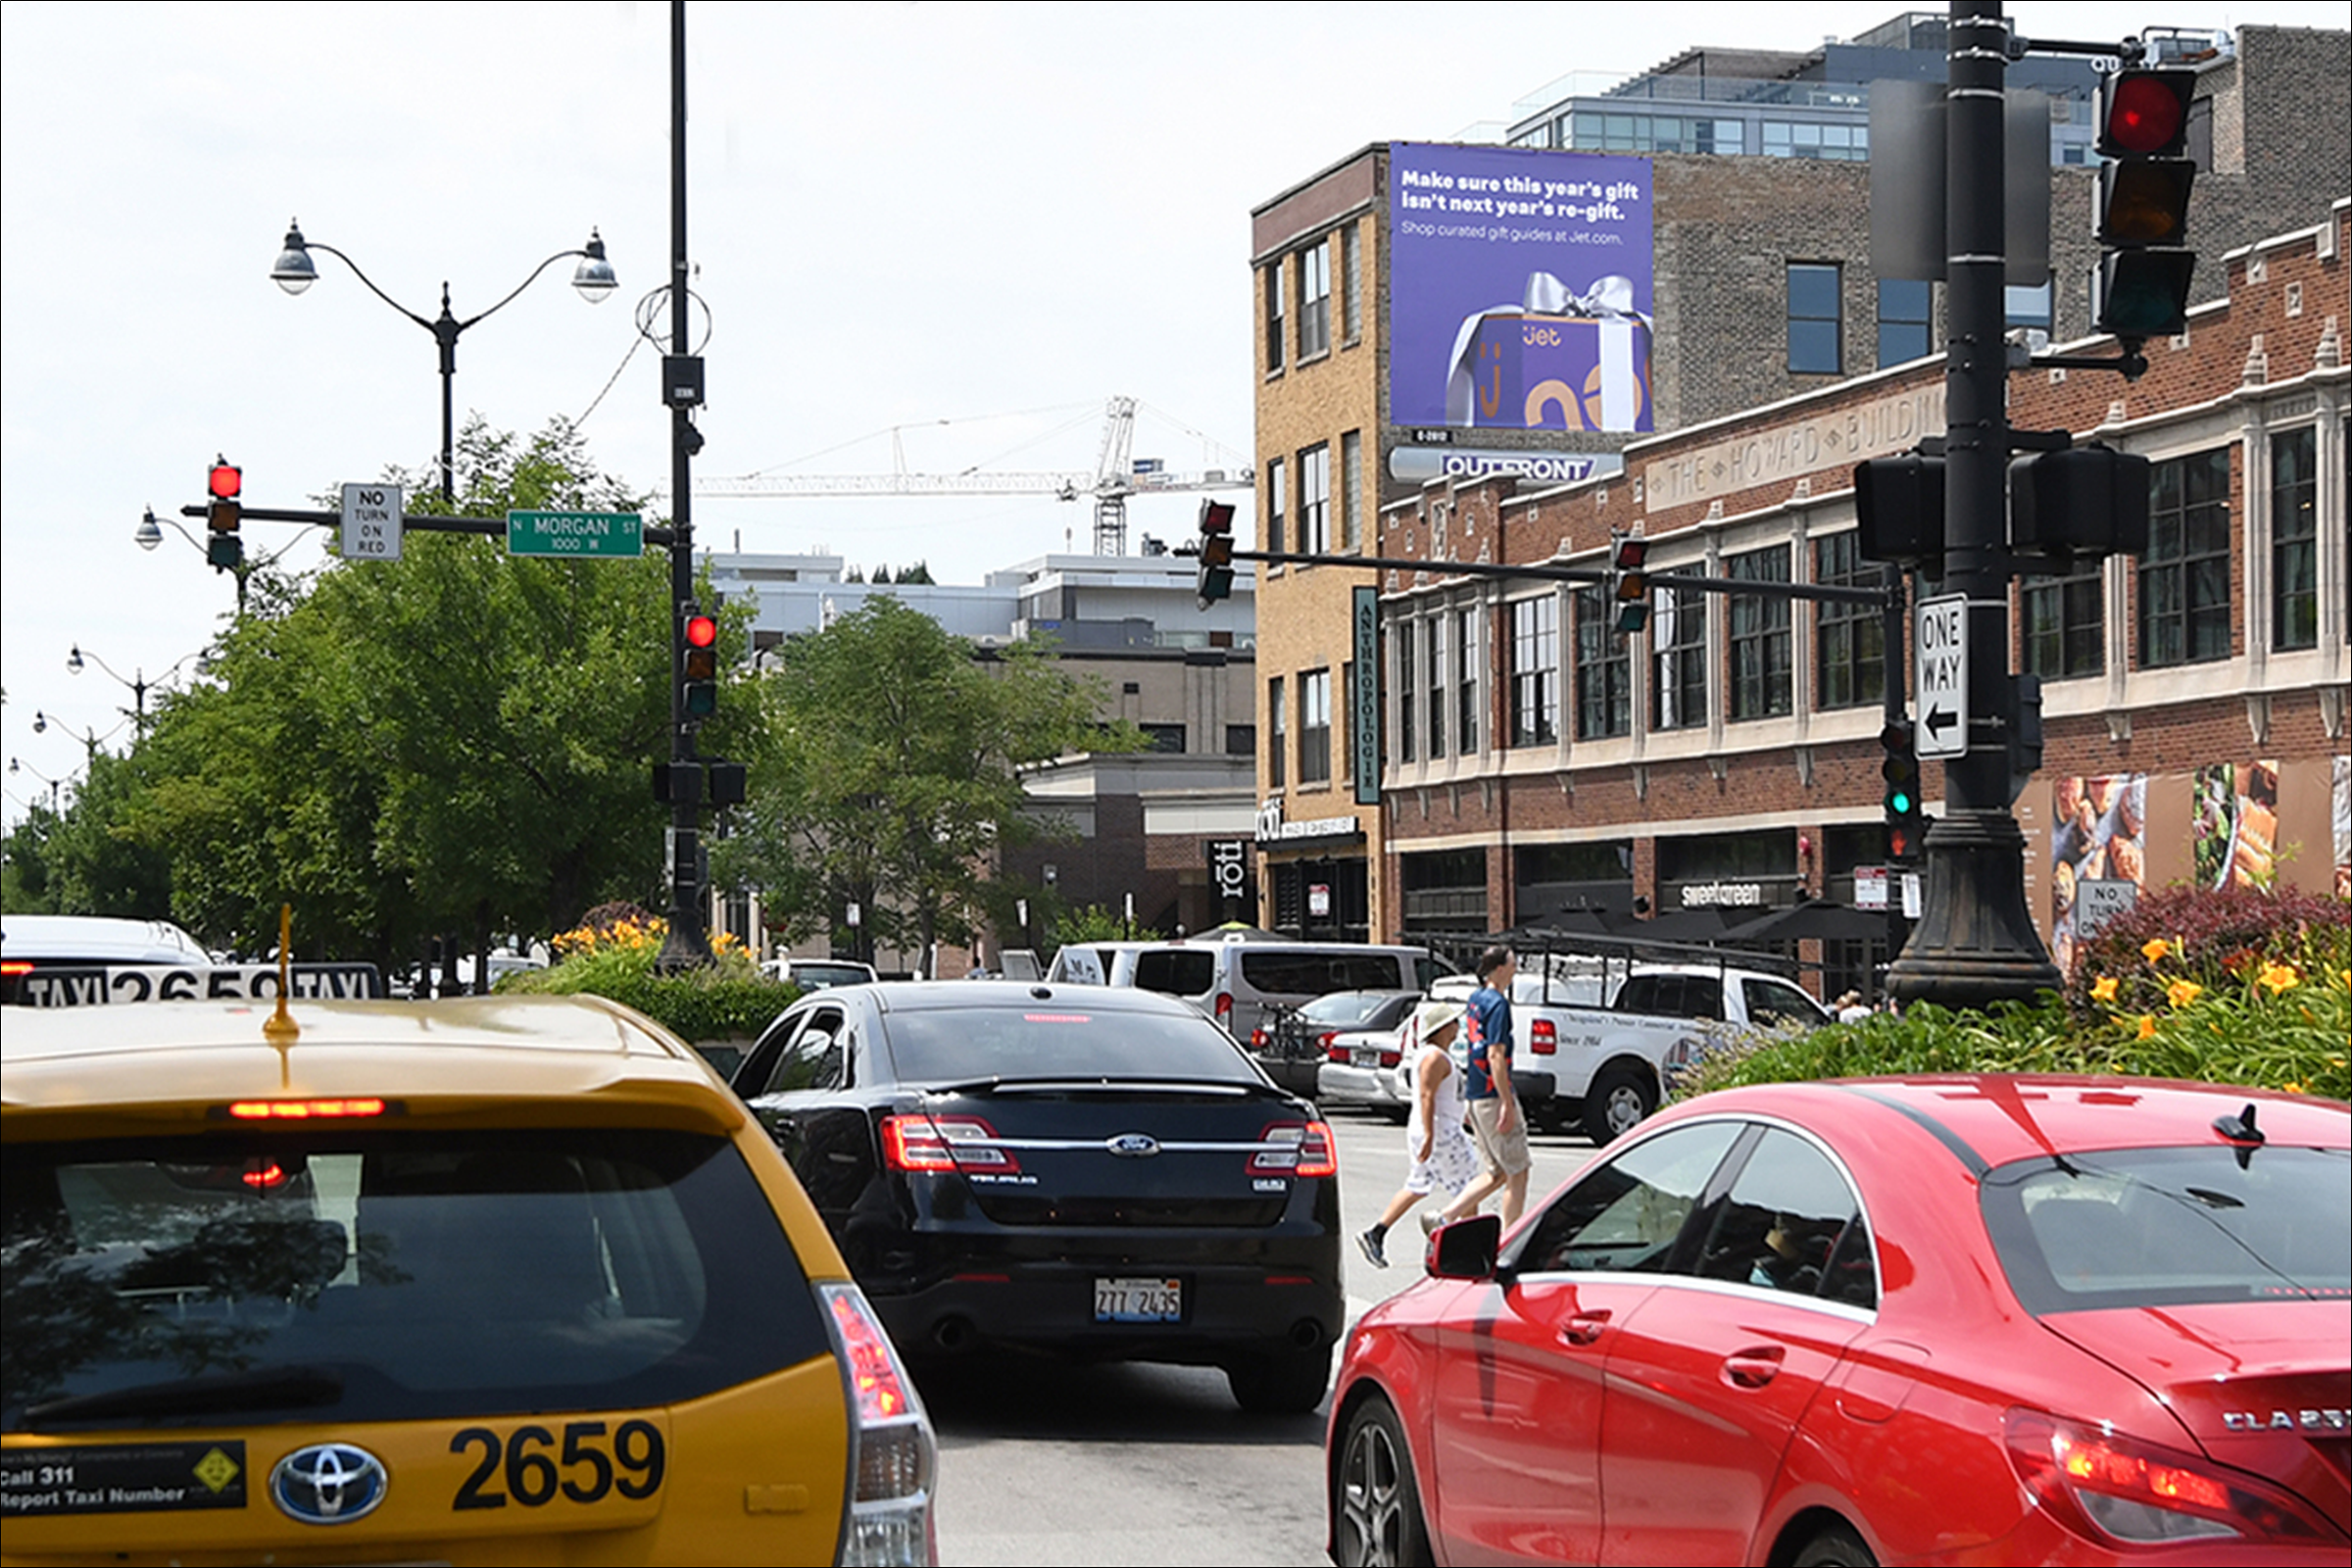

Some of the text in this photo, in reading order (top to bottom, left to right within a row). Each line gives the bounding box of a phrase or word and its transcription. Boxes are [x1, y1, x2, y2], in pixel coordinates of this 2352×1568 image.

[1401, 170, 1639, 203] Make sure this year's gift
[1401, 191, 1626, 223] isn't next year's re-gift.
[1401, 220, 1623, 245] Shop curated gift guides at Jet.com.
[1668, 392, 1946, 499] THE HOWARD BUILDIN
[1446, 457, 1588, 480] OUTFRONT
[360, 491, 385, 506] NO
[356, 509, 388, 521] TURN
[514, 518, 637, 535] N MORGAN ST
[362, 525, 381, 537] ON
[358, 541, 385, 554] RED
[552, 540, 599, 551] 1000 W
[1922, 610, 1959, 651] ONE
[1922, 654, 1961, 692] WAY
[1359, 604, 1374, 789] ANTHROPOLOGIE
[2094, 888, 2117, 901] NO
[27, 977, 103, 1007] TAXI
[297, 973, 368, 1000] TAXI
[1139, 1291, 1178, 1315] 2435
[2223, 1409, 2351, 1430] CLA 25
[1, 1466, 74, 1487] Call 311
[450, 1419, 665, 1511] 2659
[1, 1491, 60, 1510] Report
[66, 1488, 104, 1504] Taxi
[109, 1487, 186, 1503] Number
